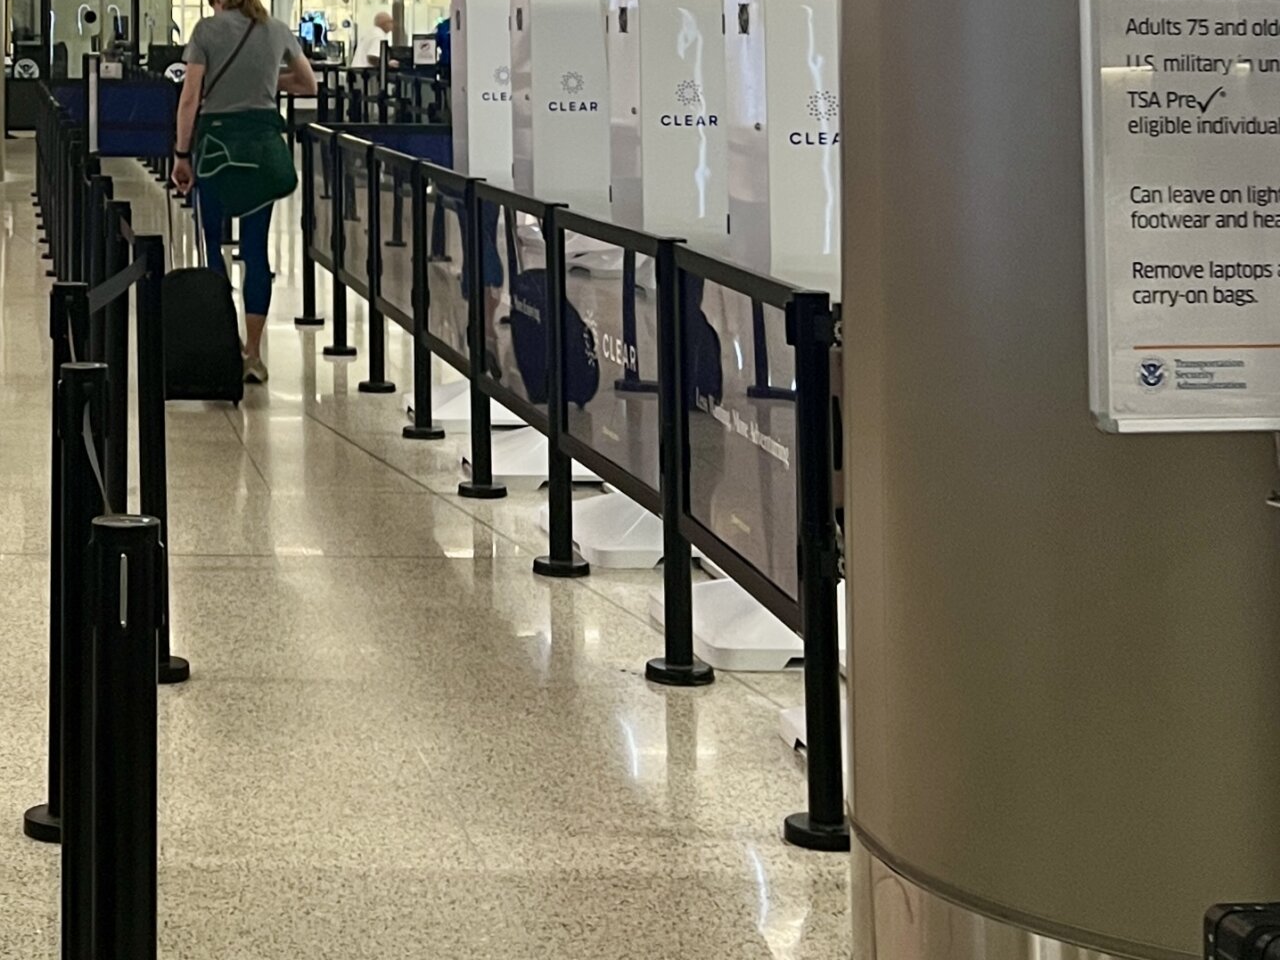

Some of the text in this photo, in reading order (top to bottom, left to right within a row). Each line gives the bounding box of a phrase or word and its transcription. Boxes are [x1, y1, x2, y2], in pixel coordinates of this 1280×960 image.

[1126, 17, 1280, 36] Adults 75 and old
[1126, 55, 1157, 72] US.
[1164, 54, 1232, 75] military
[482, 91, 512, 101] CLE
[1127, 91, 1161, 108] TSA
[548, 101, 598, 112] CLEAR
[661, 114, 718, 127] CLEAR
[1128, 116, 1192, 137] eligible
[1130, 186, 1163, 204] Can
[1168, 185, 1215, 204] leave
[1220, 189, 1242, 204] on
[1131, 210, 1211, 229] footwear
[1215, 211, 1248, 228] and
[1132, 262, 1204, 279] Remove
[1209, 261, 1273, 281] laptops
[1132, 286, 1259, 307] carry-on bags.
[602, 333, 637, 372] CLEAR
